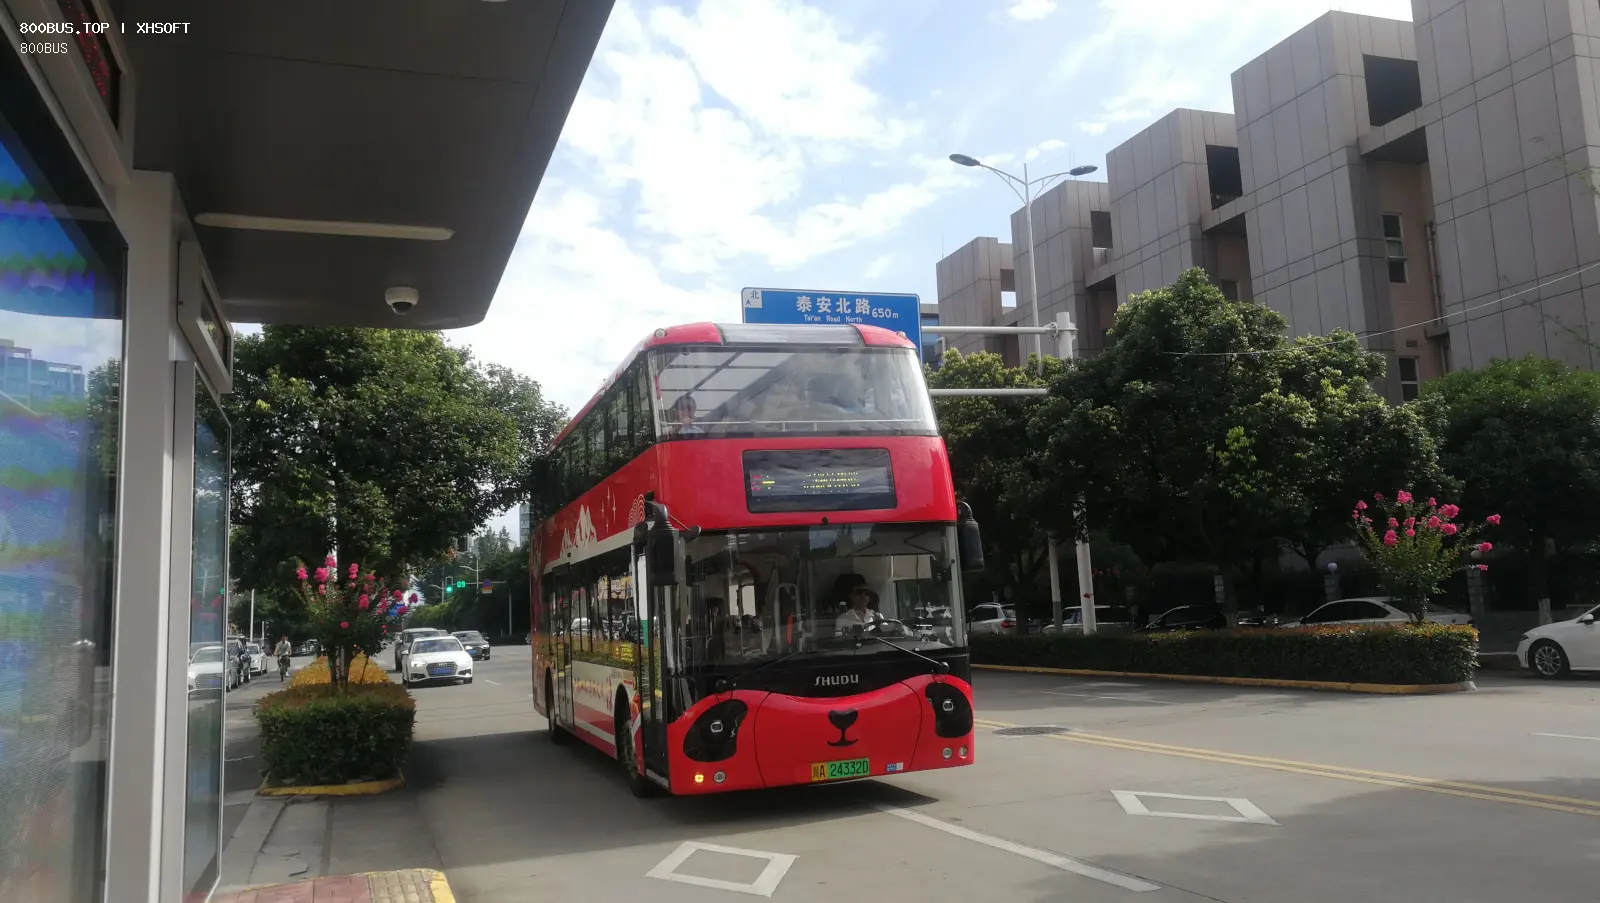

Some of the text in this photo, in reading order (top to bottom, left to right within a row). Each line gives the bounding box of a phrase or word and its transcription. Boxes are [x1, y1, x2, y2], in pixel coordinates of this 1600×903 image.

[750, 289, 760, 300] 北
[796, 295, 899, 319] 泰安北路 650m
[826, 314, 841, 323] Road
[845, 315, 863, 323] North
[814, 674, 859, 686] SHUDU
[830, 760, 869, 777] 24332D
